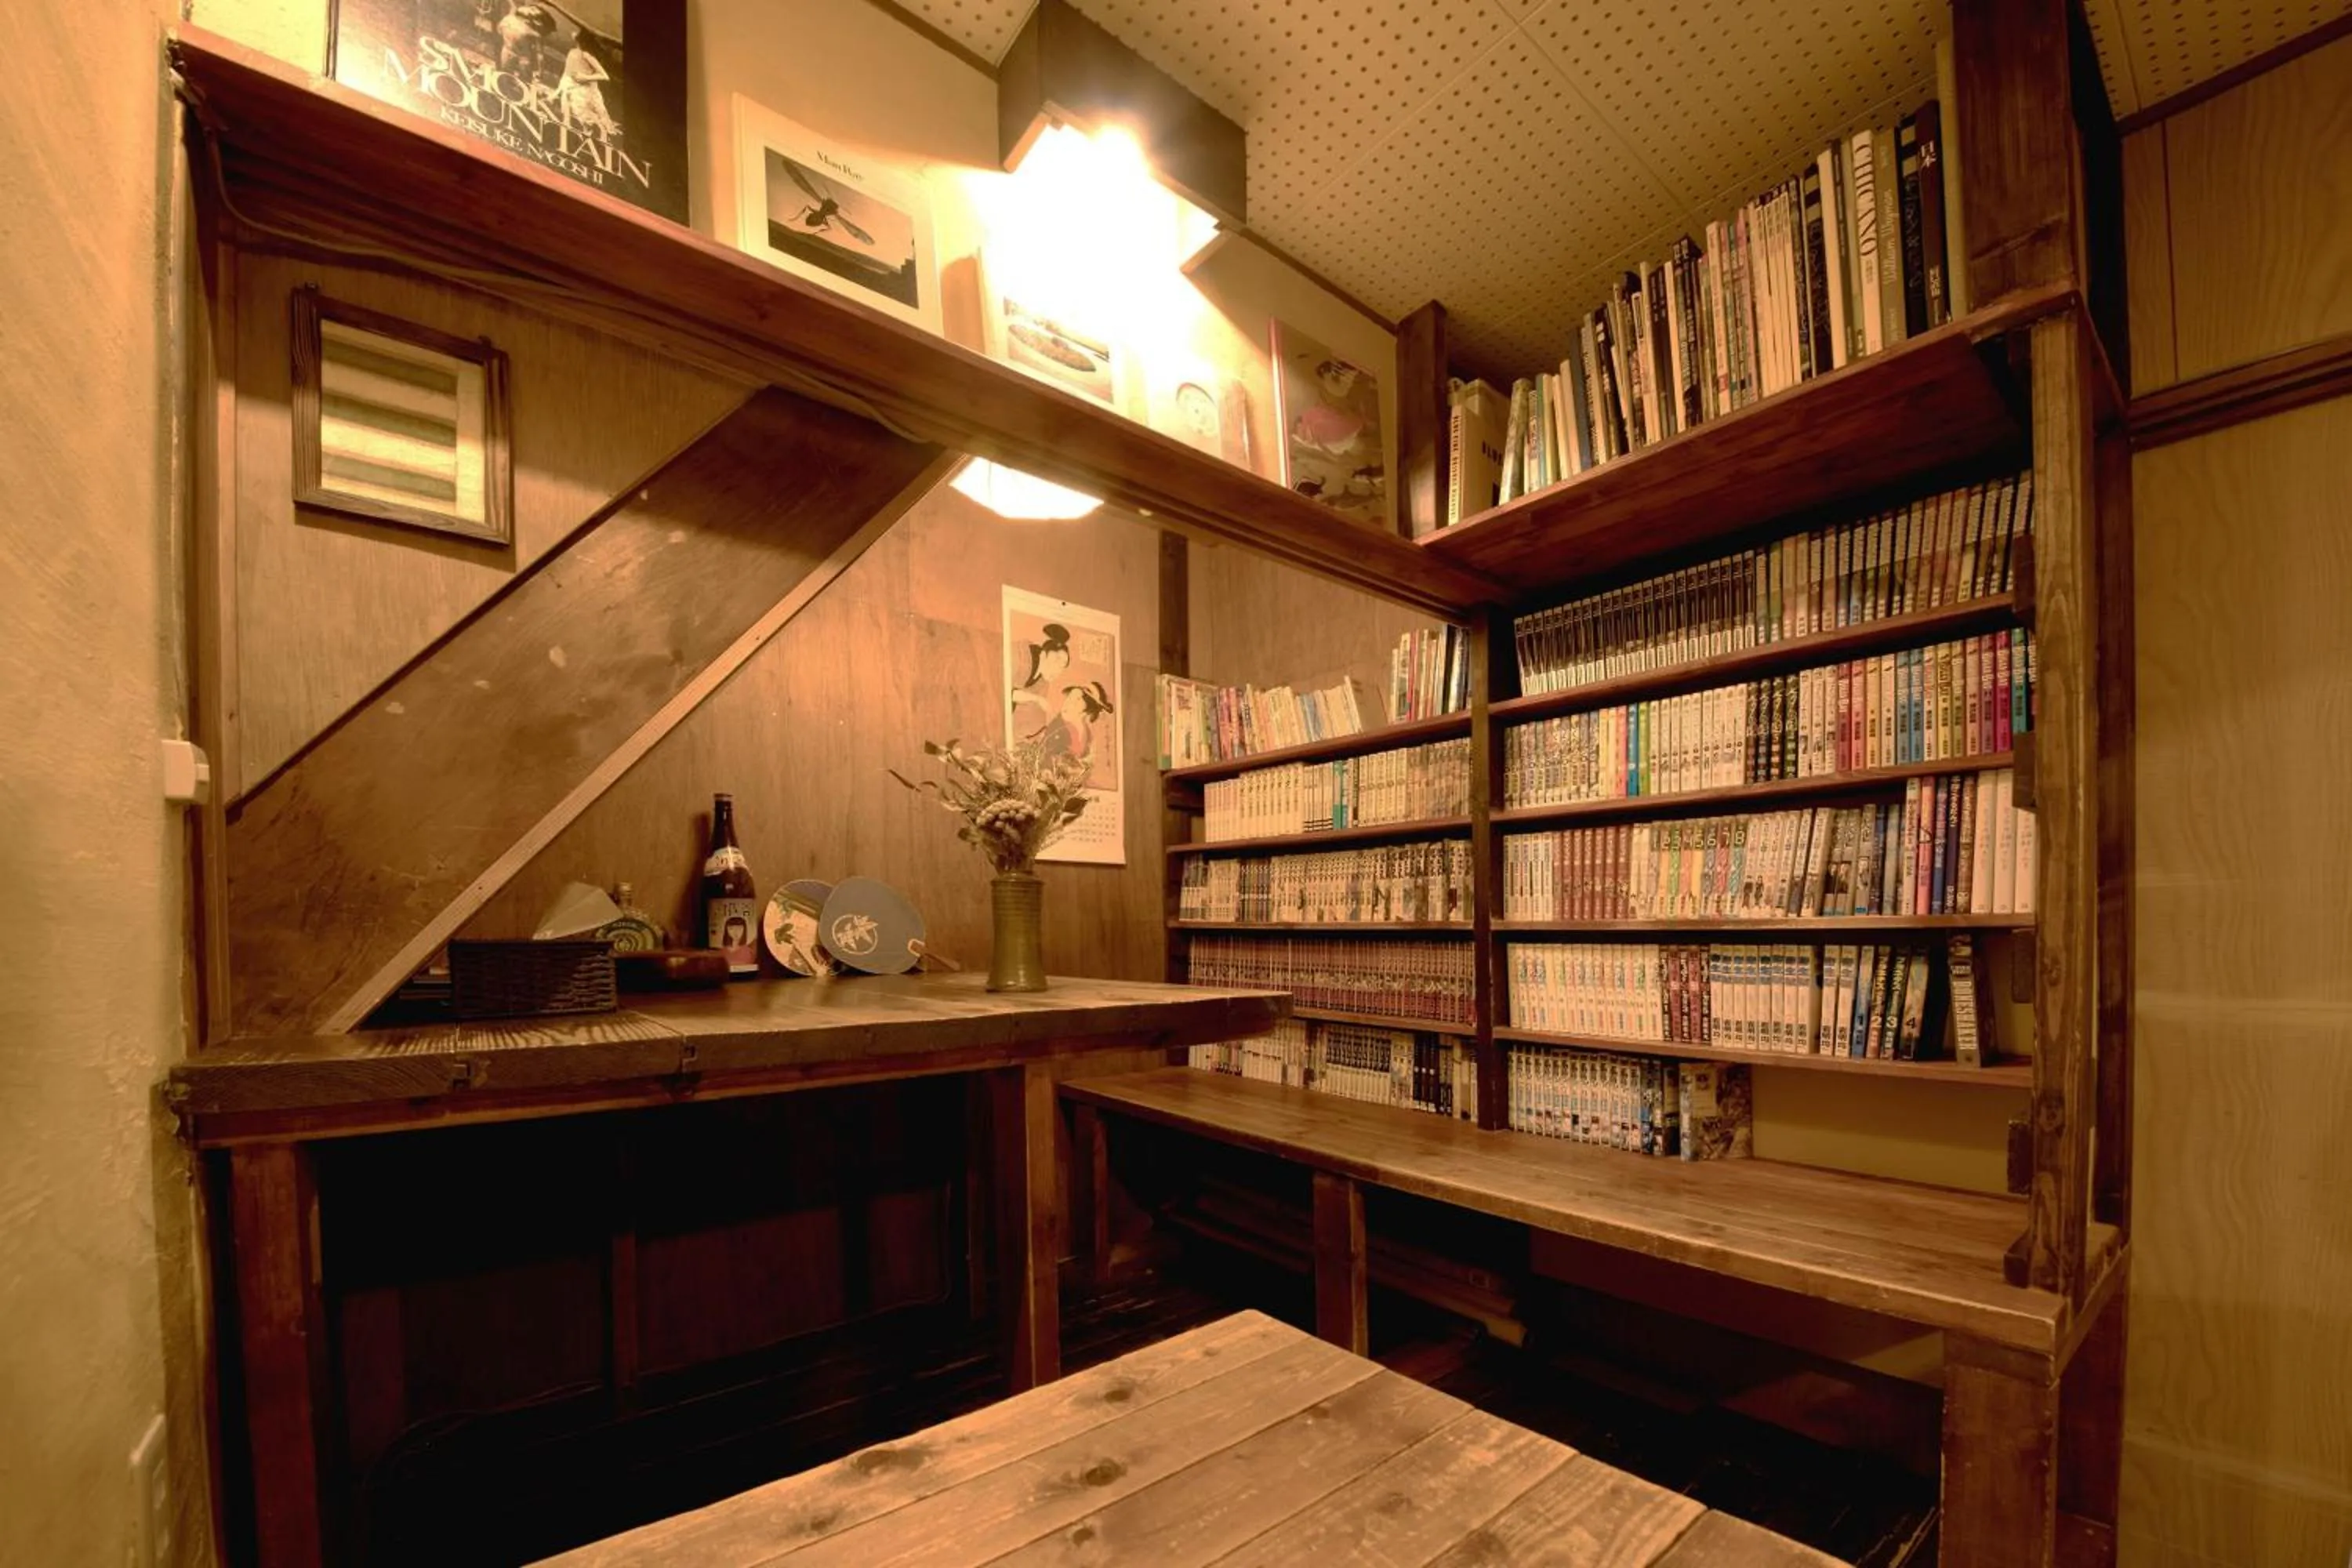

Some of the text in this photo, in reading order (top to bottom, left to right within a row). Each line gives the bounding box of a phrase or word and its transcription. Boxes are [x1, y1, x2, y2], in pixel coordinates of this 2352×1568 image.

[381, 47, 653, 189] MOUNTAIN
[439, 105, 523, 152] KEISUKE
[1853, 143, 1878, 256] CHICANO
